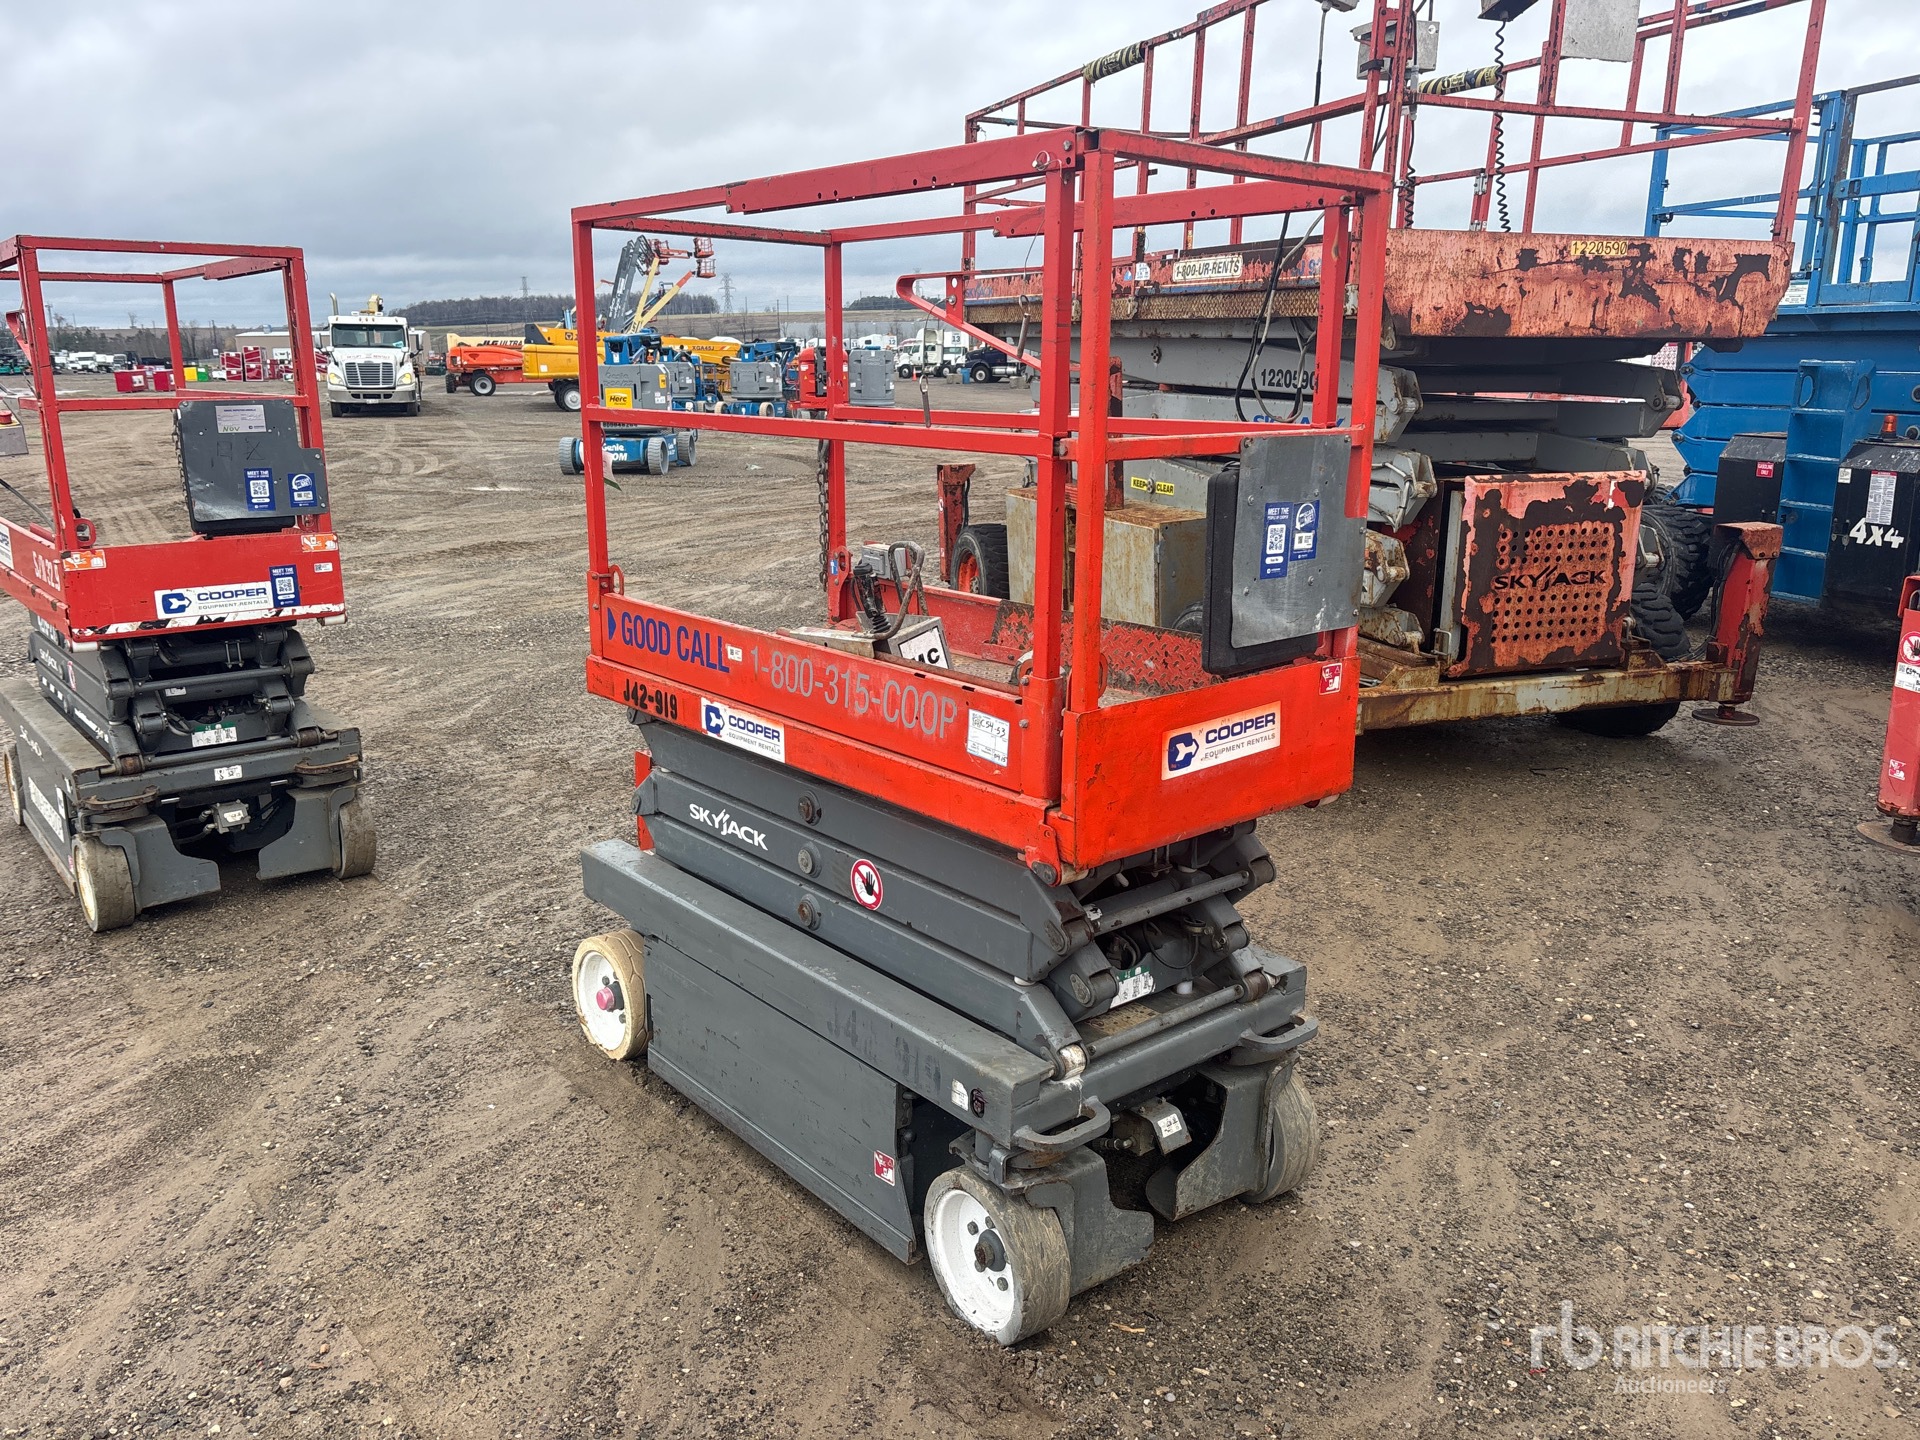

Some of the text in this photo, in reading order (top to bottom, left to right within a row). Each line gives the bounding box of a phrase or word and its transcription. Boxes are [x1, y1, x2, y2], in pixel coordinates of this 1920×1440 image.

[1572, 241, 1628, 255] 1220590
[1175, 258, 1240, 279] 1-800-UR-RENTS
[602, 442, 625, 452] Genie
[1132, 478, 1174, 493] KEEP CLEAR
[1267, 507, 1290, 515] MEET THE
[1494, 565, 1606, 592] SKYJACK
[197, 587, 268, 602] COOPER
[198, 602, 237, 610] EQUIPMENT
[621, 611, 730, 674] GOOD CALL
[623, 678, 678, 721] J42-919
[750, 645, 958, 739] 1-800-315-COOP
[728, 714, 781, 743] COOPER
[1205, 711, 1276, 744] COOPER
[728, 732, 781, 756] EQUIPMENT RENTALS
[1204, 732, 1276, 760] EQUIPMENT RENTALS
[689, 803, 769, 851] SKYJACK
